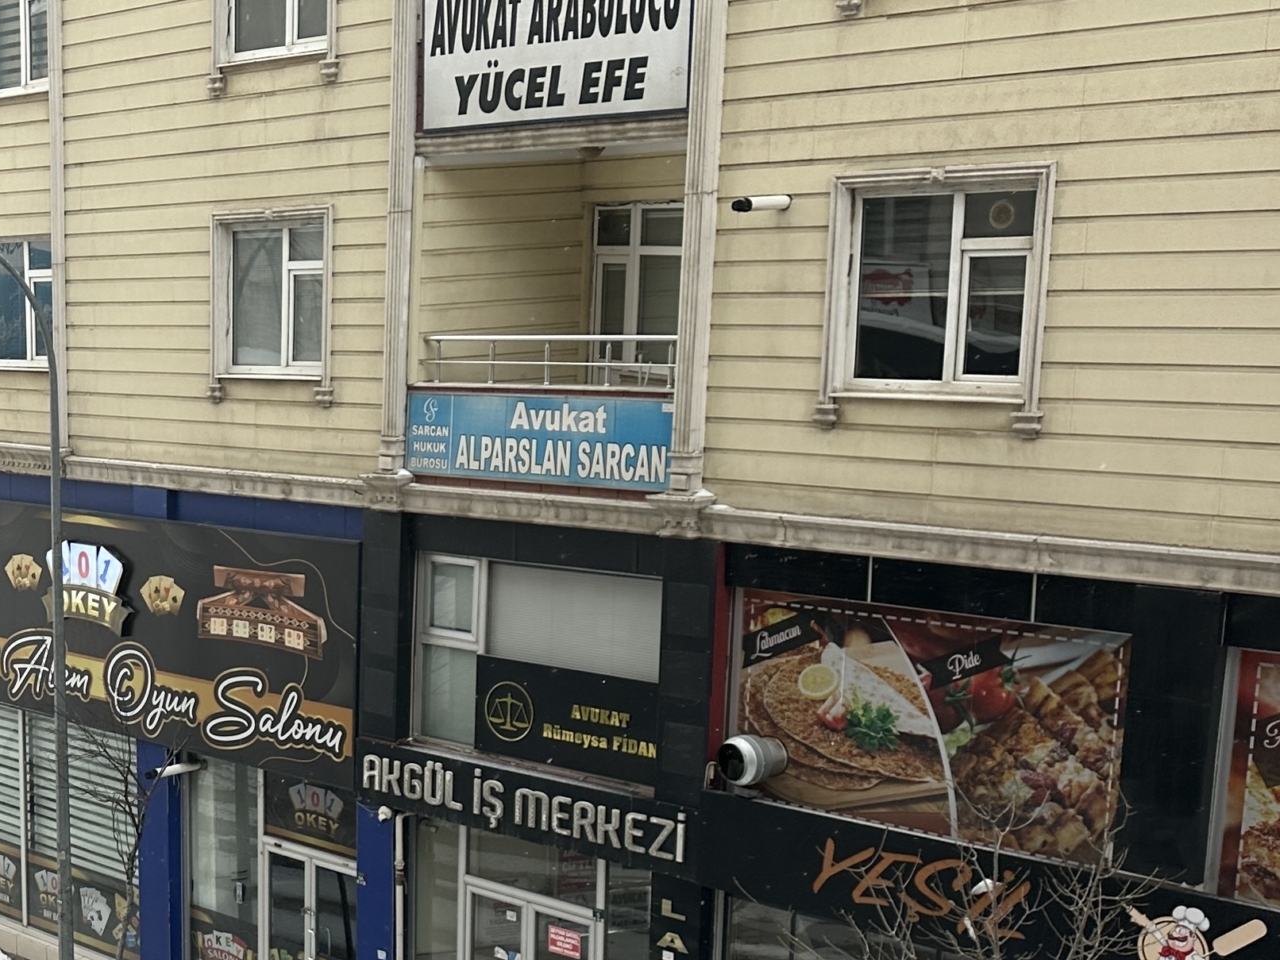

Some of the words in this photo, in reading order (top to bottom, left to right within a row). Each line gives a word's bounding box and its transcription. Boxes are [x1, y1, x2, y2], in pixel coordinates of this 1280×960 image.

[430, 0, 518, 57] AVUKAT
[455, 59, 565, 115] YÜCEL
[579, 56, 649, 104] EFE
[411, 425, 449, 437] SARCAN
[510, 401, 607, 434] Avukat
[410, 456, 448, 470] BÜROSU
[413, 441, 447, 454] HUKUK
[455, 435, 572, 477] ALPARSLAN
[577, 441, 667, 484] SARCAN
[750, 623, 802, 659] Lahmacun
[947, 650, 982, 680] Pide
[107, 648, 197, 730] Oyun
[206, 676, 344, 753] Salonu
[570, 704, 630, 728] AVUKAT
[543, 723, 608, 749] Rümeysa
[612, 734, 657, 759] FİDAN
[297, 788, 335, 812] 101
[363, 753, 463, 811] AKGÜL
[473, 767, 505, 829] İŞ
[514, 787, 687, 864] MERKEZİ
[294, 811, 339, 836] OKEY
[813, 837, 1032, 940] YEŞİL
